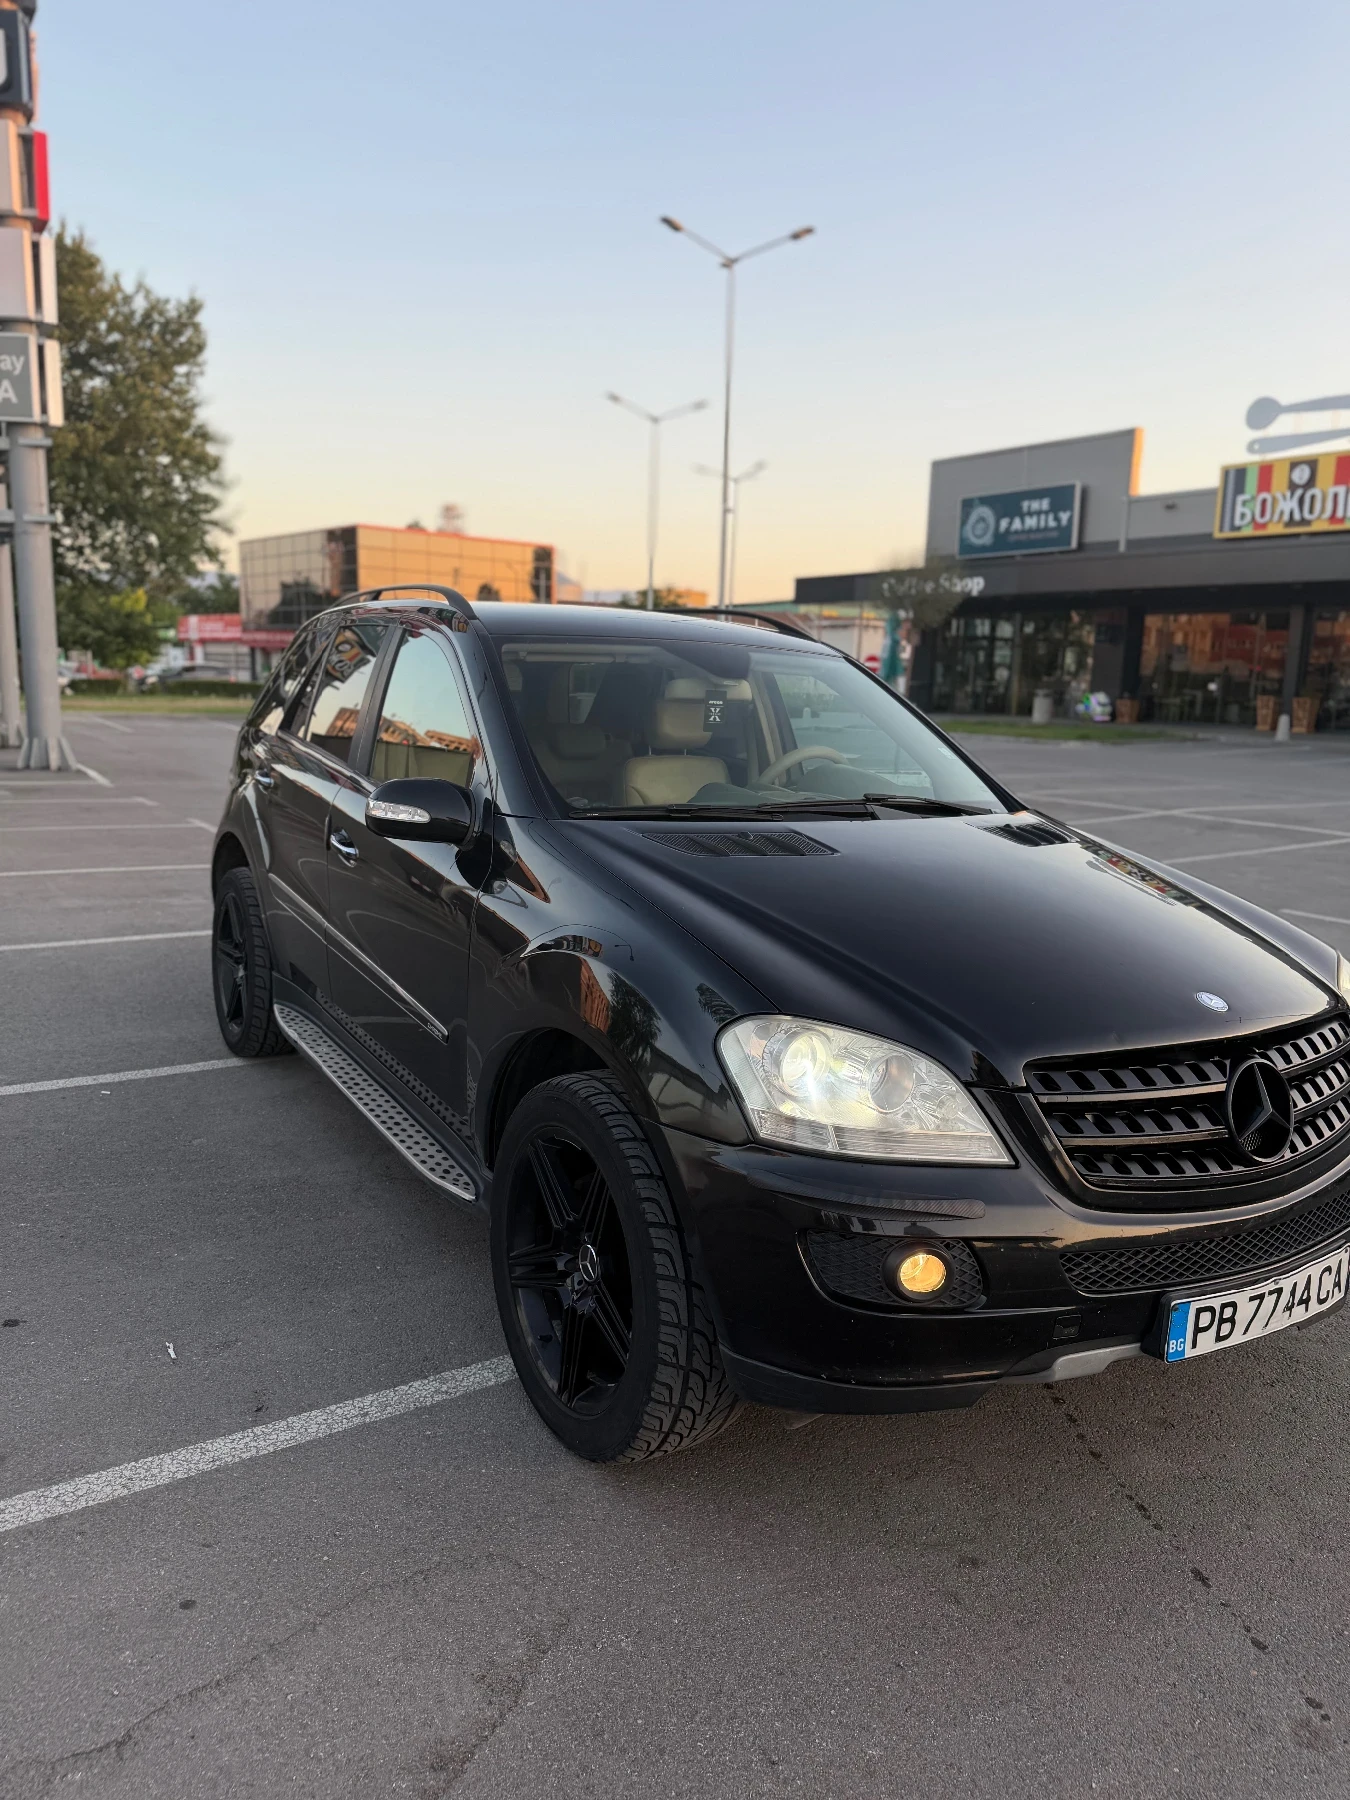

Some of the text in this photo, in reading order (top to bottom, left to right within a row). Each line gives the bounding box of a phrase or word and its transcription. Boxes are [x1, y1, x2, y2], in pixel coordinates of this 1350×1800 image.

[1020, 497, 1051, 513] THE
[1234, 484, 1350, 527] БОЖОЛ
[999, 510, 1072, 534] FAMILY
[1169, 1338, 1185, 1353] BG
